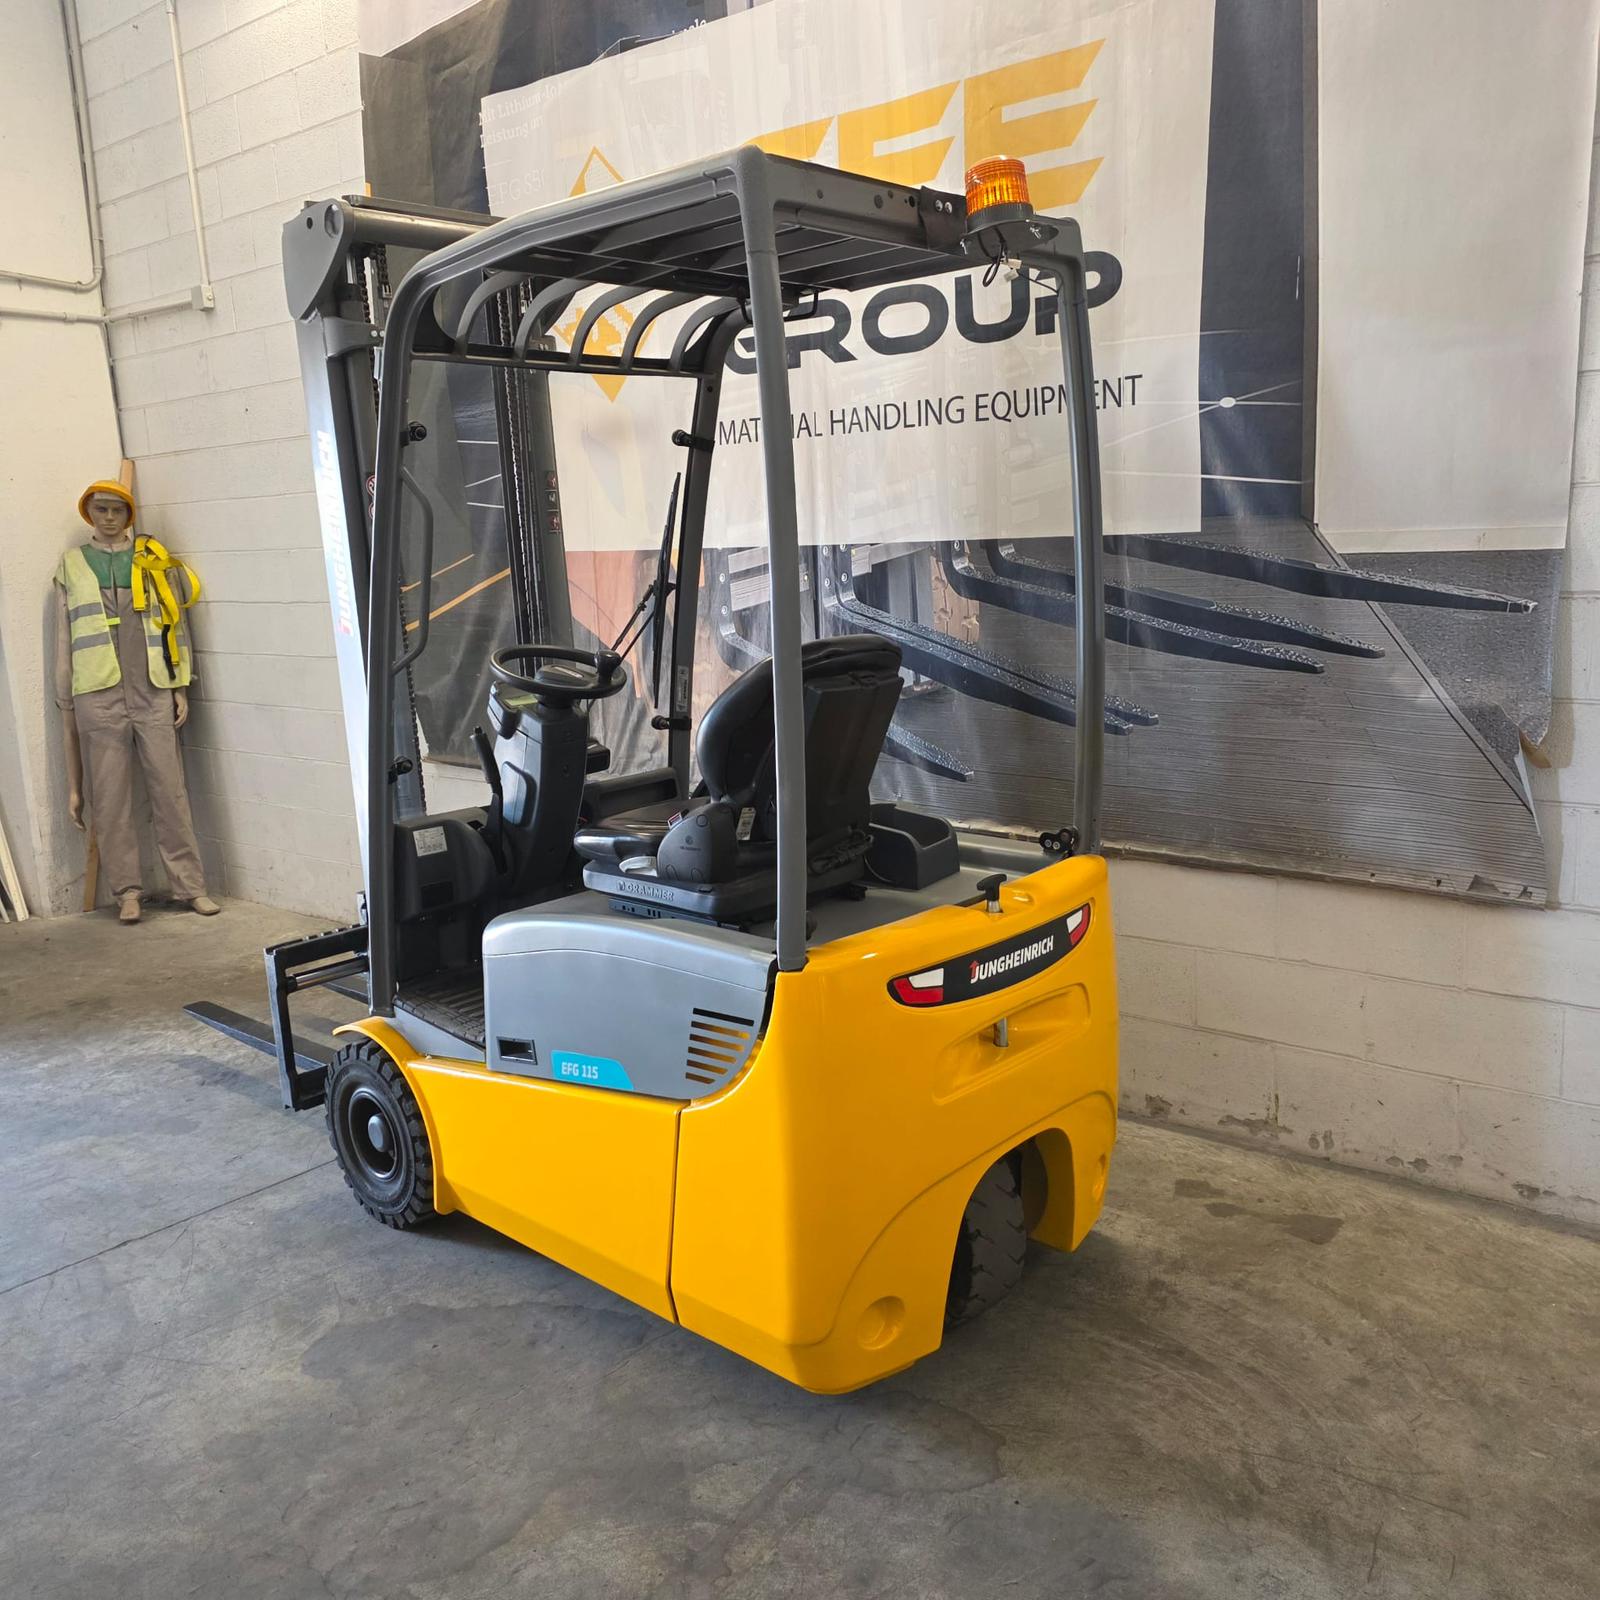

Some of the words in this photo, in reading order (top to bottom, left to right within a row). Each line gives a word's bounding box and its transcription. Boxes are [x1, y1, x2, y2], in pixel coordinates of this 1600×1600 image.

[719, 411, 822, 445] MATIAL
[830, 395, 965, 435] HANDLING
[627, 883, 674, 901] GRAMMER
[969, 935, 1054, 984] JUNGHEINRICH
[561, 1062, 579, 1077] EFG
[581, 1065, 599, 1080] 115
